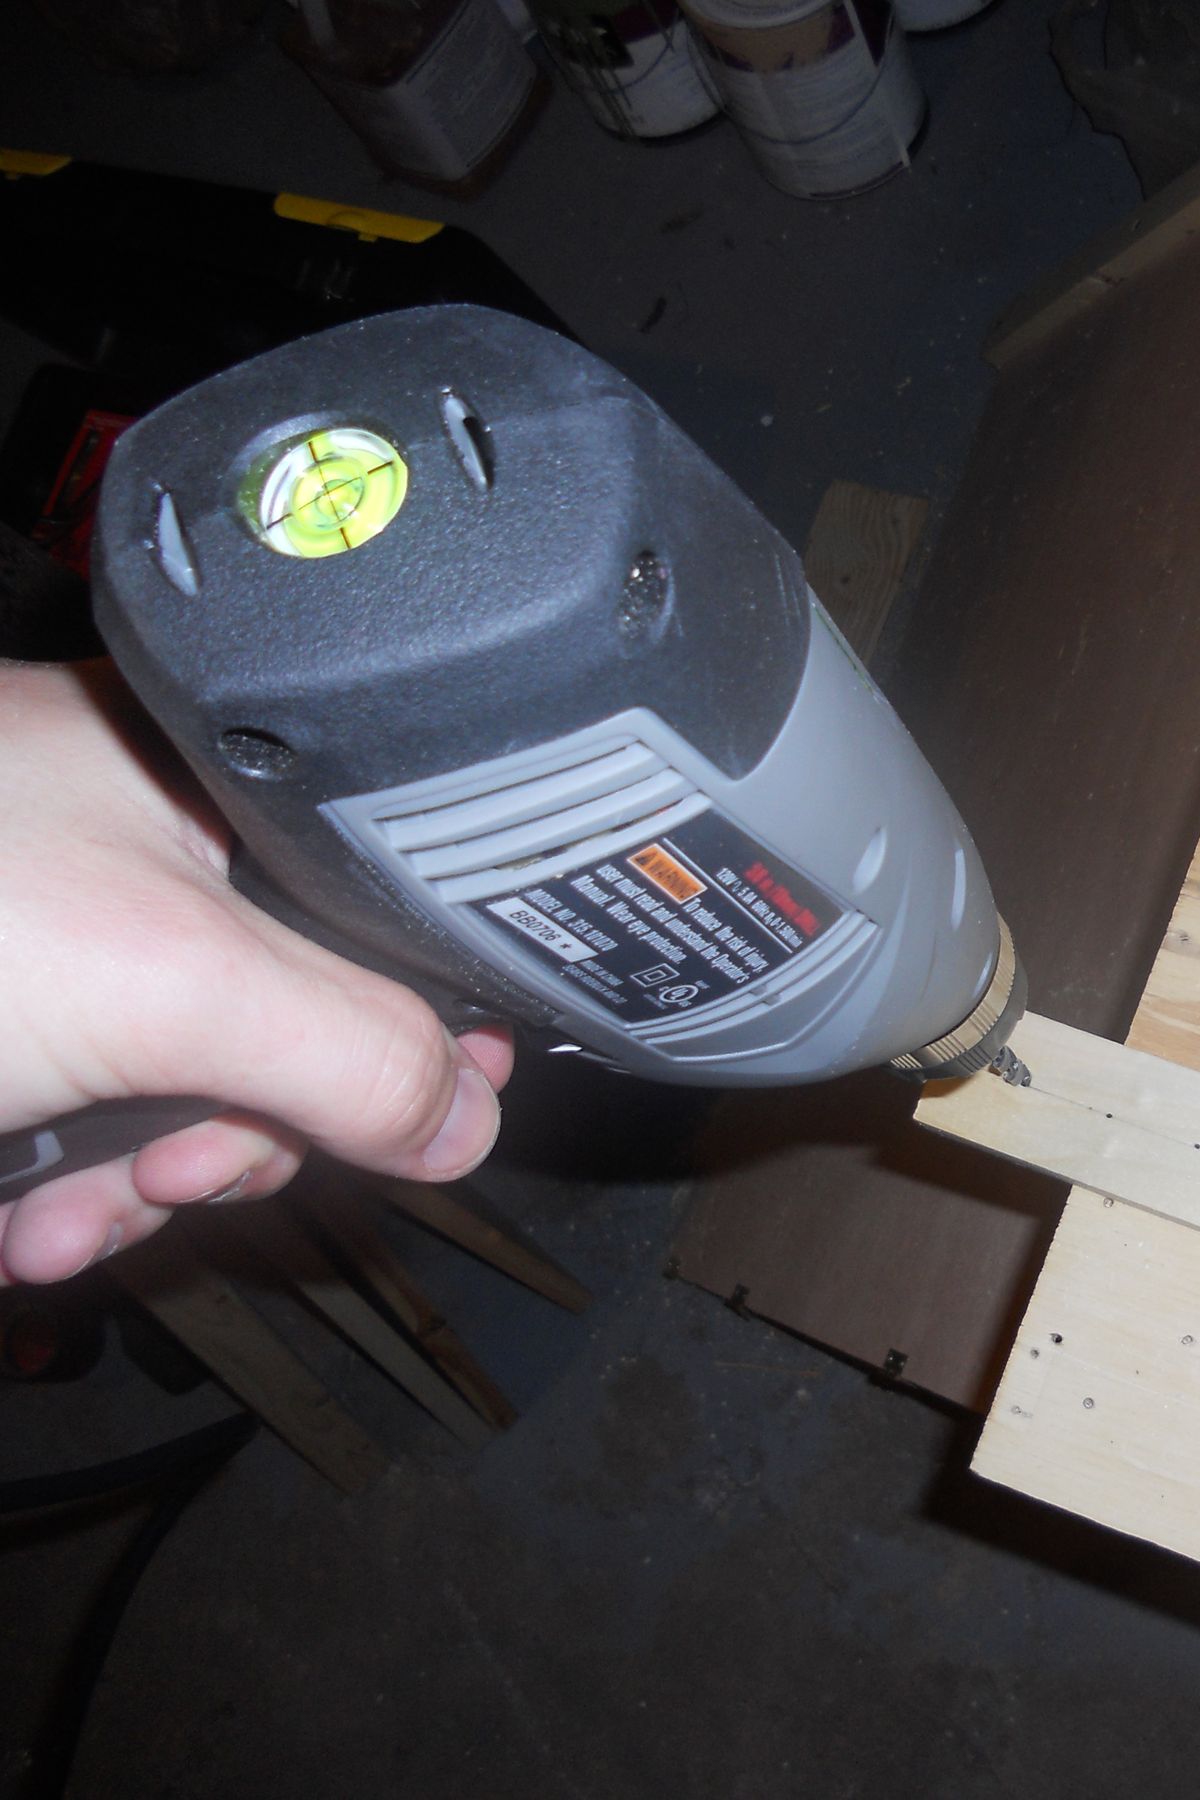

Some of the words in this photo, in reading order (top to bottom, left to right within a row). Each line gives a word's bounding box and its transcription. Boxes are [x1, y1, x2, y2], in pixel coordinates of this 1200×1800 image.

[524, 886, 563, 912] MODEL
[597, 863, 623, 883] user
[613, 877, 646, 899] must
[633, 892, 664, 913] read
[650, 906, 677, 924] and
[664, 916, 712, 952] understand
[699, 943, 719, 961] the
[682, 897, 701, 914] To
[509, 908, 561, 942] BB0706
[605, 899, 636, 925] Wear
[626, 917, 651, 936] eye
[690, 905, 722, 932] reduce
[714, 925, 734, 942] the
[725, 934, 748, 953] risk
[737, 944, 755, 958] of
